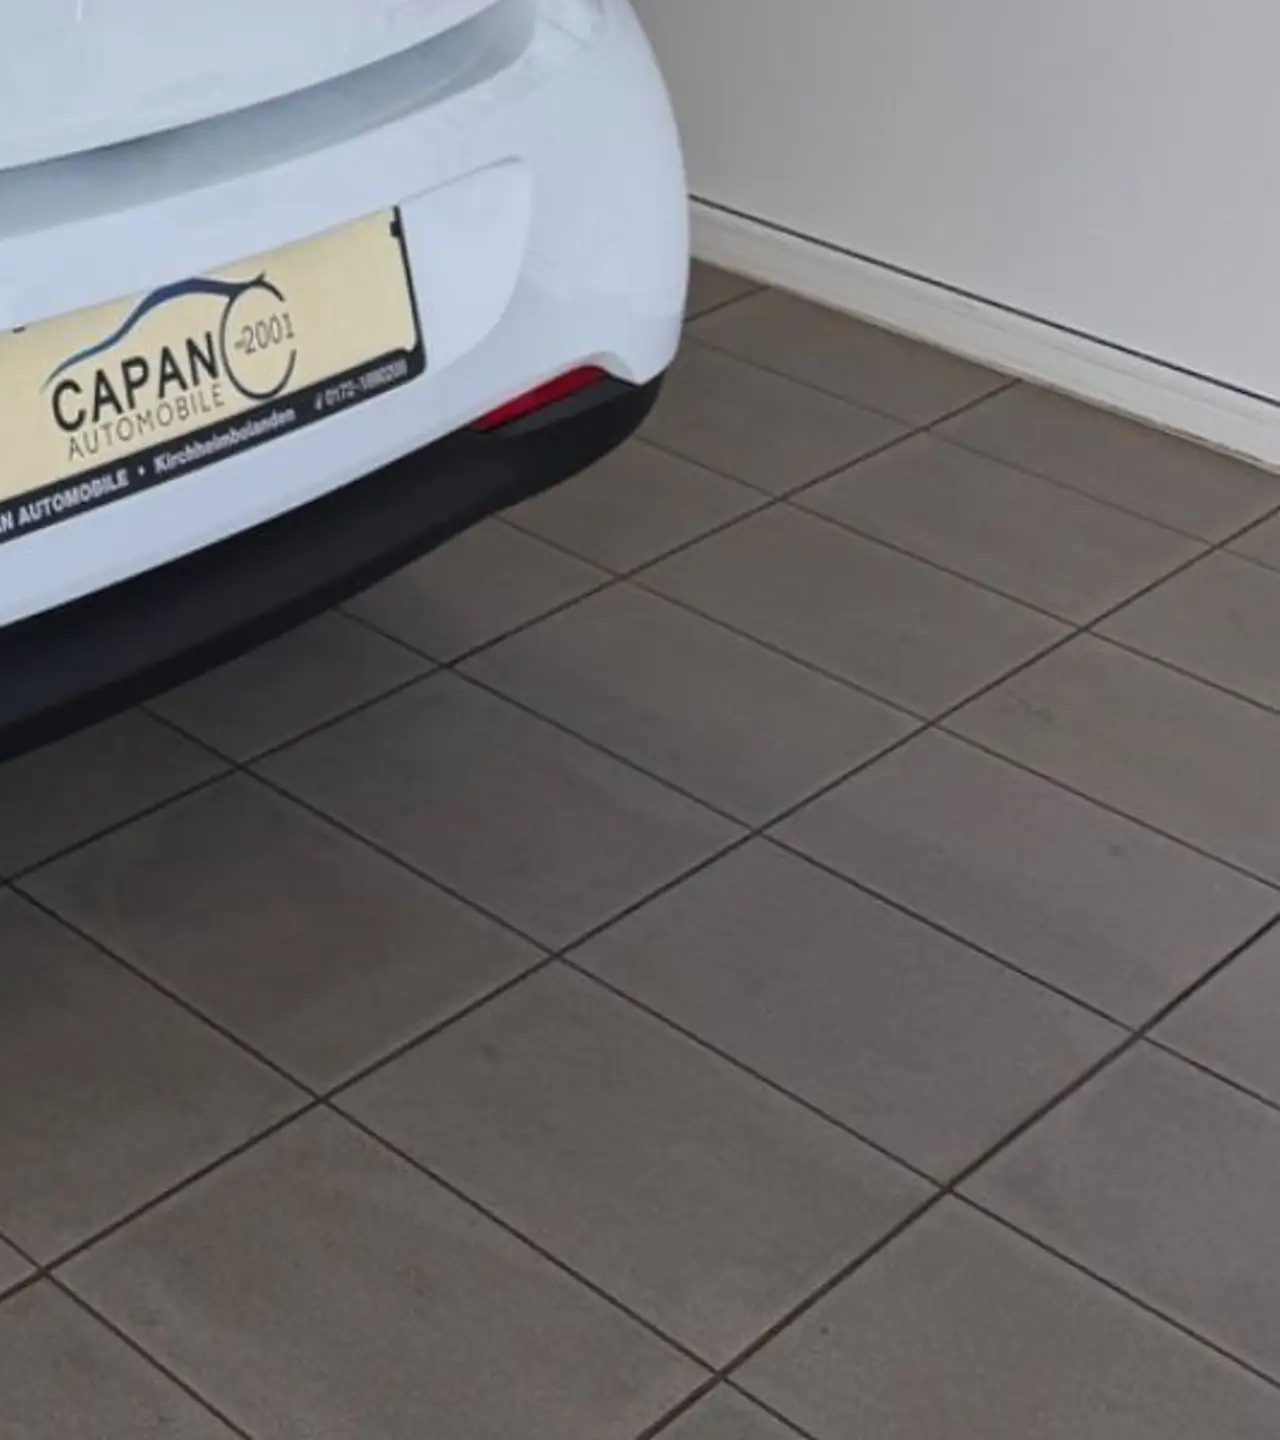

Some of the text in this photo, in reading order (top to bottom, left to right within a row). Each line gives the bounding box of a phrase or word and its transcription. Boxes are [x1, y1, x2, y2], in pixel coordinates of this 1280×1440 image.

[51, 330, 218, 433] CAPAN
[68, 383, 225, 461] AUTOMOBILE
[18, 468, 129, 526] AUTOMOBILE
